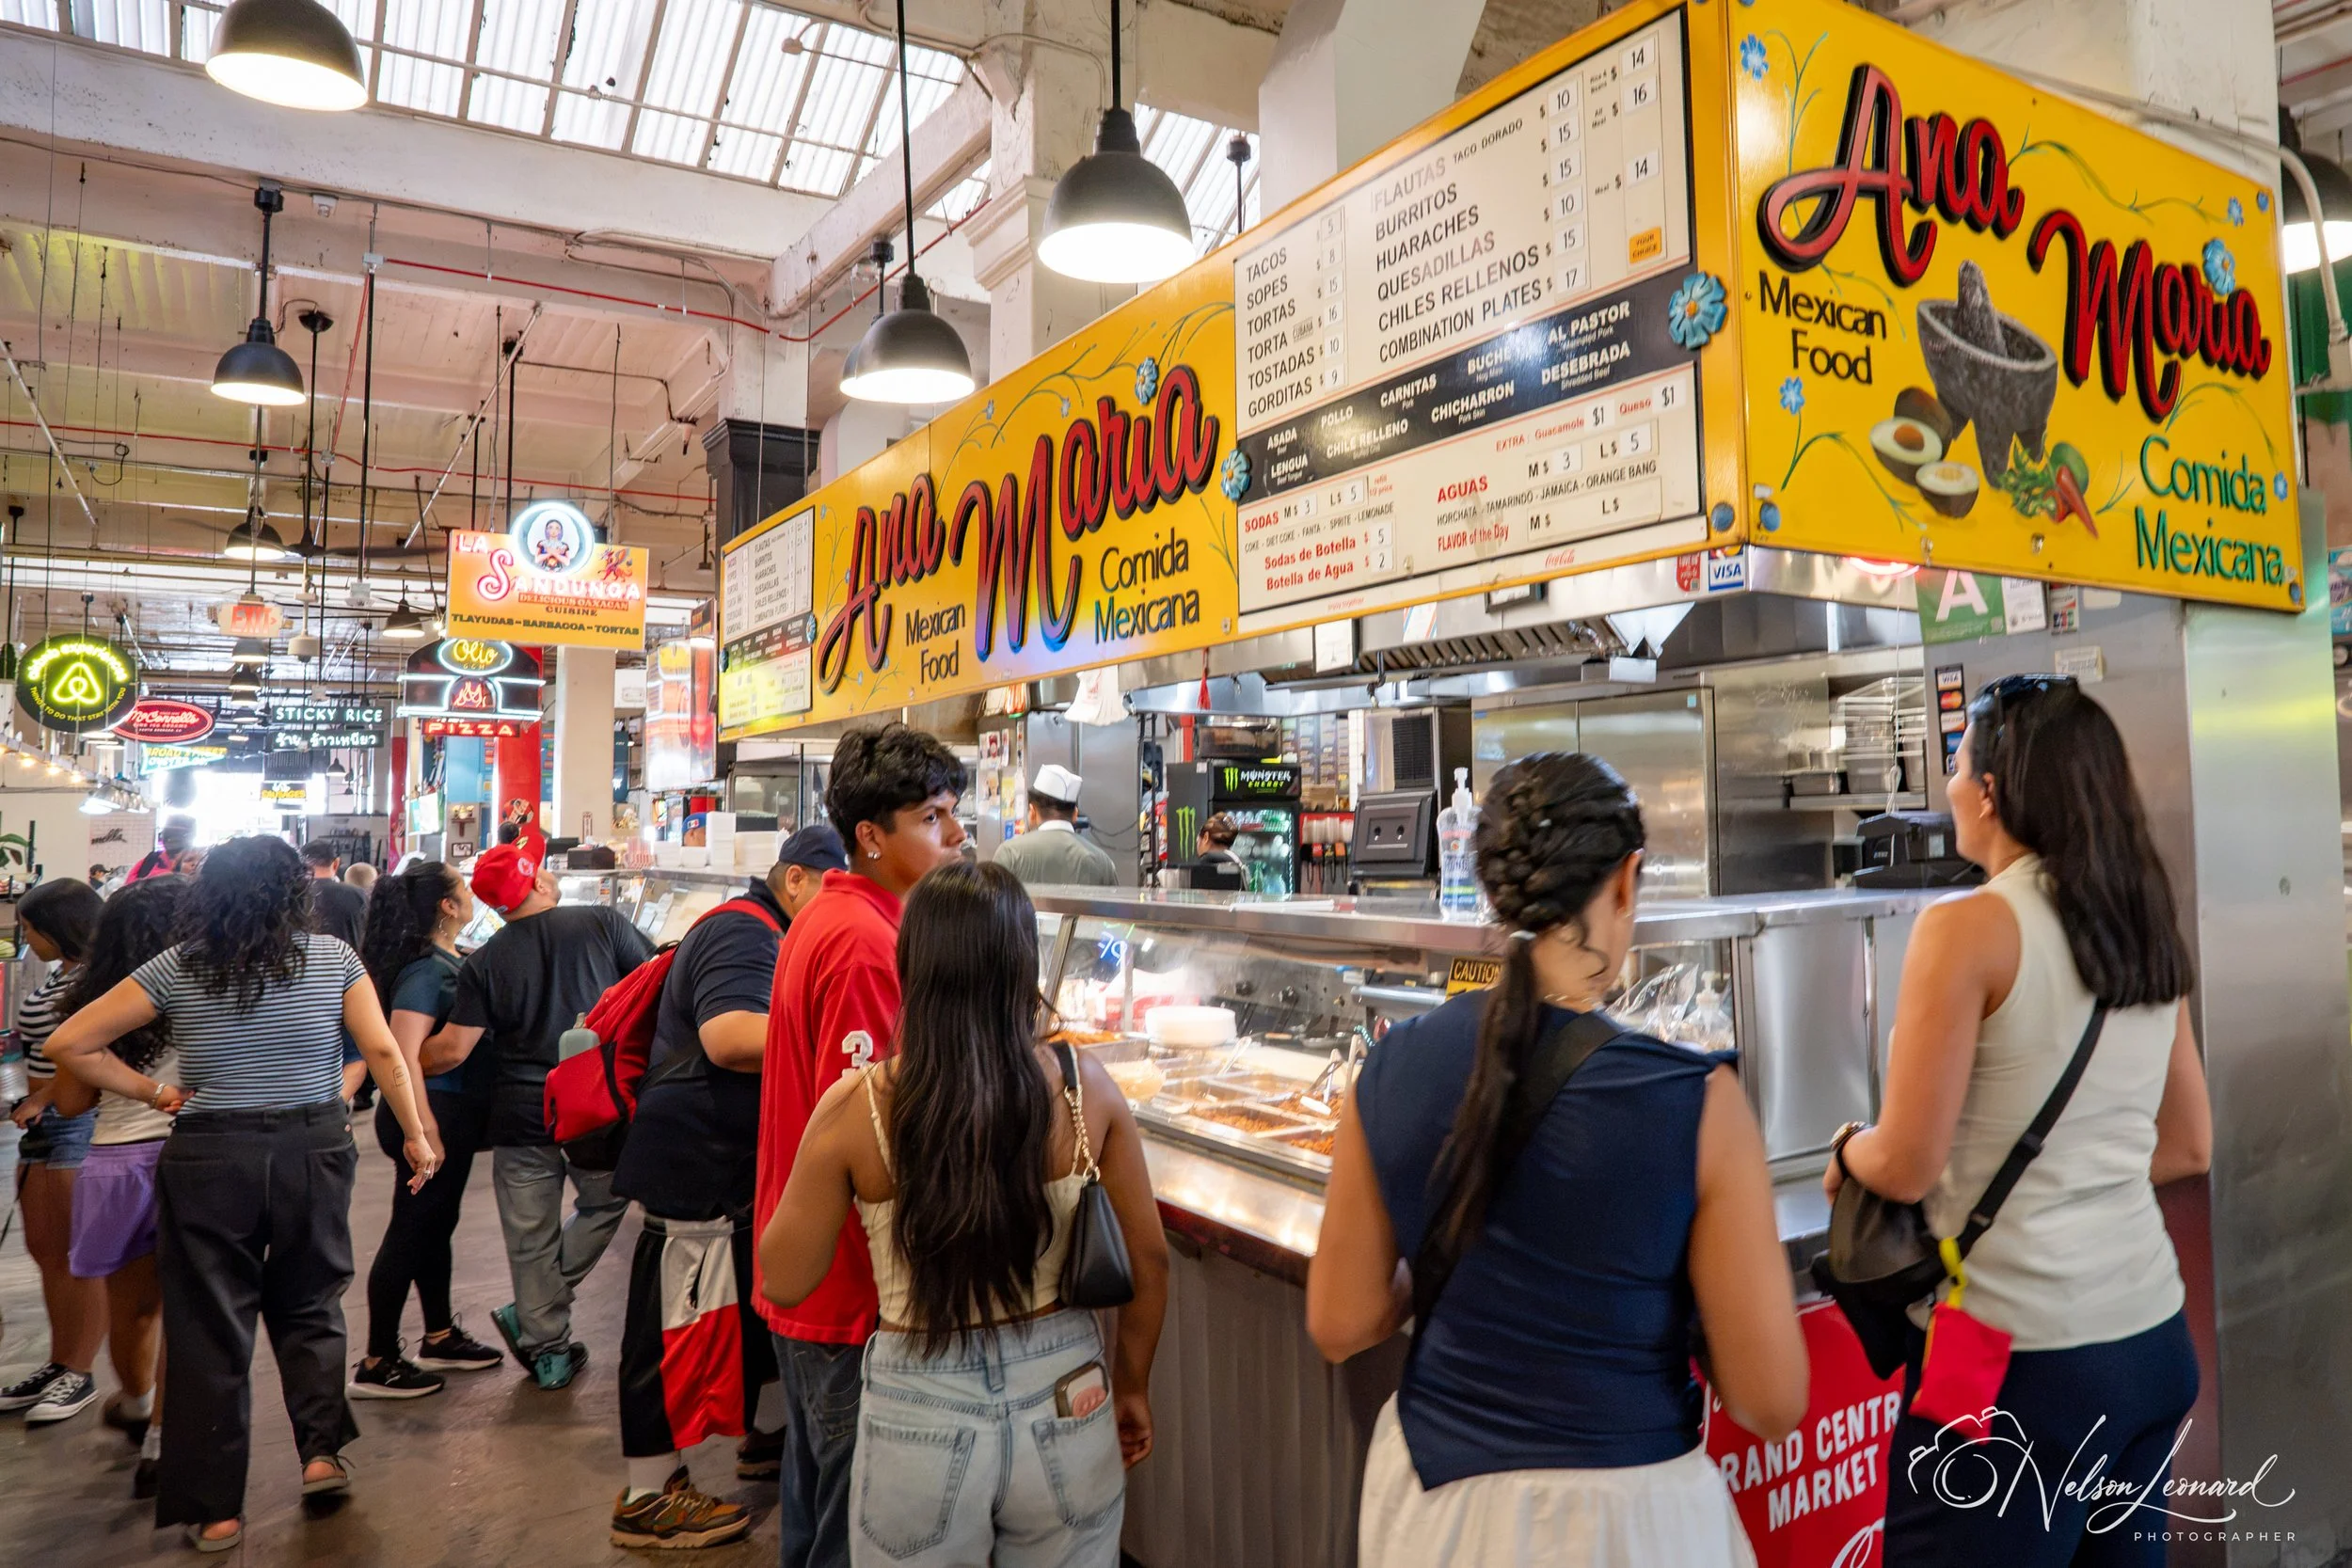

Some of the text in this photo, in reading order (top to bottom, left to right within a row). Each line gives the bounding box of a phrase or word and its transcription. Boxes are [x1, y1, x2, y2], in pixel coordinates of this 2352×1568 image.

[1631, 47, 1645, 70] 14
[1633, 83, 1646, 106] 16
[1374, 89, 1570, 214] FLAUTAS TACO DORADO 10
[1635, 157, 1647, 180] 14
[1756, 62, 2026, 286] Ana
[1375, 123, 1571, 242] BURRITOS 15
[1376, 158, 1572, 273] HUARACHES 15
[1247, 217, 1334, 283] TACOS 5
[1377, 194, 1575, 301] QUESADILLAS 10
[1247, 248, 1335, 310] SOPES 8
[1378, 229, 1576, 332] CHILES RELLENOS 15
[1248, 277, 1338, 337] TORTAS 15
[1379, 268, 1578, 363] COMBINATION PLATES 17
[1549, 327, 1567, 345] AL
[1570, 300, 1630, 337] PASTOR
[1758, 270, 1887, 341] Mexican
[2026, 208, 2272, 423] Maria
[1248, 331, 1288, 364] TORTA
[1328, 304, 1337, 323] 16
[1791, 329, 1875, 386] Food
[1248, 337, 1340, 390] TOSTADAS 10
[1468, 346, 1513, 375] BUCHE
[1542, 341, 1630, 385] DESEBRADA
[1248, 369, 1338, 418] GORDITAS 9
[1380, 372, 1438, 408] CARNITAS
[1431, 380, 1515, 423] CHICHARRON
[1534, 417, 1584, 439] Guacamole
[1592, 405, 1605, 427] $1
[1619, 397, 1652, 416] Queso
[1661, 386, 1675, 407] $1
[1267, 426, 1297, 451] ASADA
[1321, 405, 1354, 430] POLLO
[1327, 436, 1357, 459] CHILE
[1359, 418, 1408, 448] RELLENO
[1271, 452, 1309, 480] LENGUA
[1437, 431, 1640, 504] AGUAS M 3 L 5
[2139, 435, 2267, 515] Comida
[1245, 484, 1357, 533] SODAS 3 5
[1437, 459, 1657, 527] HORCHATA TAMARINDO JAMAICA ORANGE BANG
[456, 534, 488, 553] LA
[818, 364, 1220, 697] Ana Maria
[1302, 522, 1321, 537] FANTA
[1329, 513, 1352, 530] SPRITE
[1357, 501, 1394, 524] LEMONADE
[1438, 499, 1611, 553] FLAVOR of the Day M L
[1099, 528, 1190, 594] Comida
[1264, 528, 1385, 571] Sodas de Botella 5
[1713, 562, 1741, 580] VISA
[2134, 506, 2283, 587] Mexicana
[1266, 552, 1386, 591] Botella de Agua 2
[1935, 570, 1989, 622] A
[231, 606, 272, 633] EXIT
[452, 613, 639, 635] TLAYUDAS BARBACOA TORTAS
[519, 594, 577, 606] DELICIOUS
[546, 607, 597, 616] CUISINE
[905, 602, 966, 647] Mexican
[1094, 588, 1200, 644] Mexicana
[453, 640, 499, 666] Olio
[921, 649, 960, 685] Food
[1942, 673, 1959, 684] VISA
[276, 707, 383, 722] STICKY RICE
[428, 722, 514, 736] PIZZA
[1241, 768, 1291, 783] MONSTER
[841, 1029, 873, 1078] 3
[1720, 1390, 1901, 1493] RAND CENTR
[1768, 1444, 1879, 1532] MARKET
